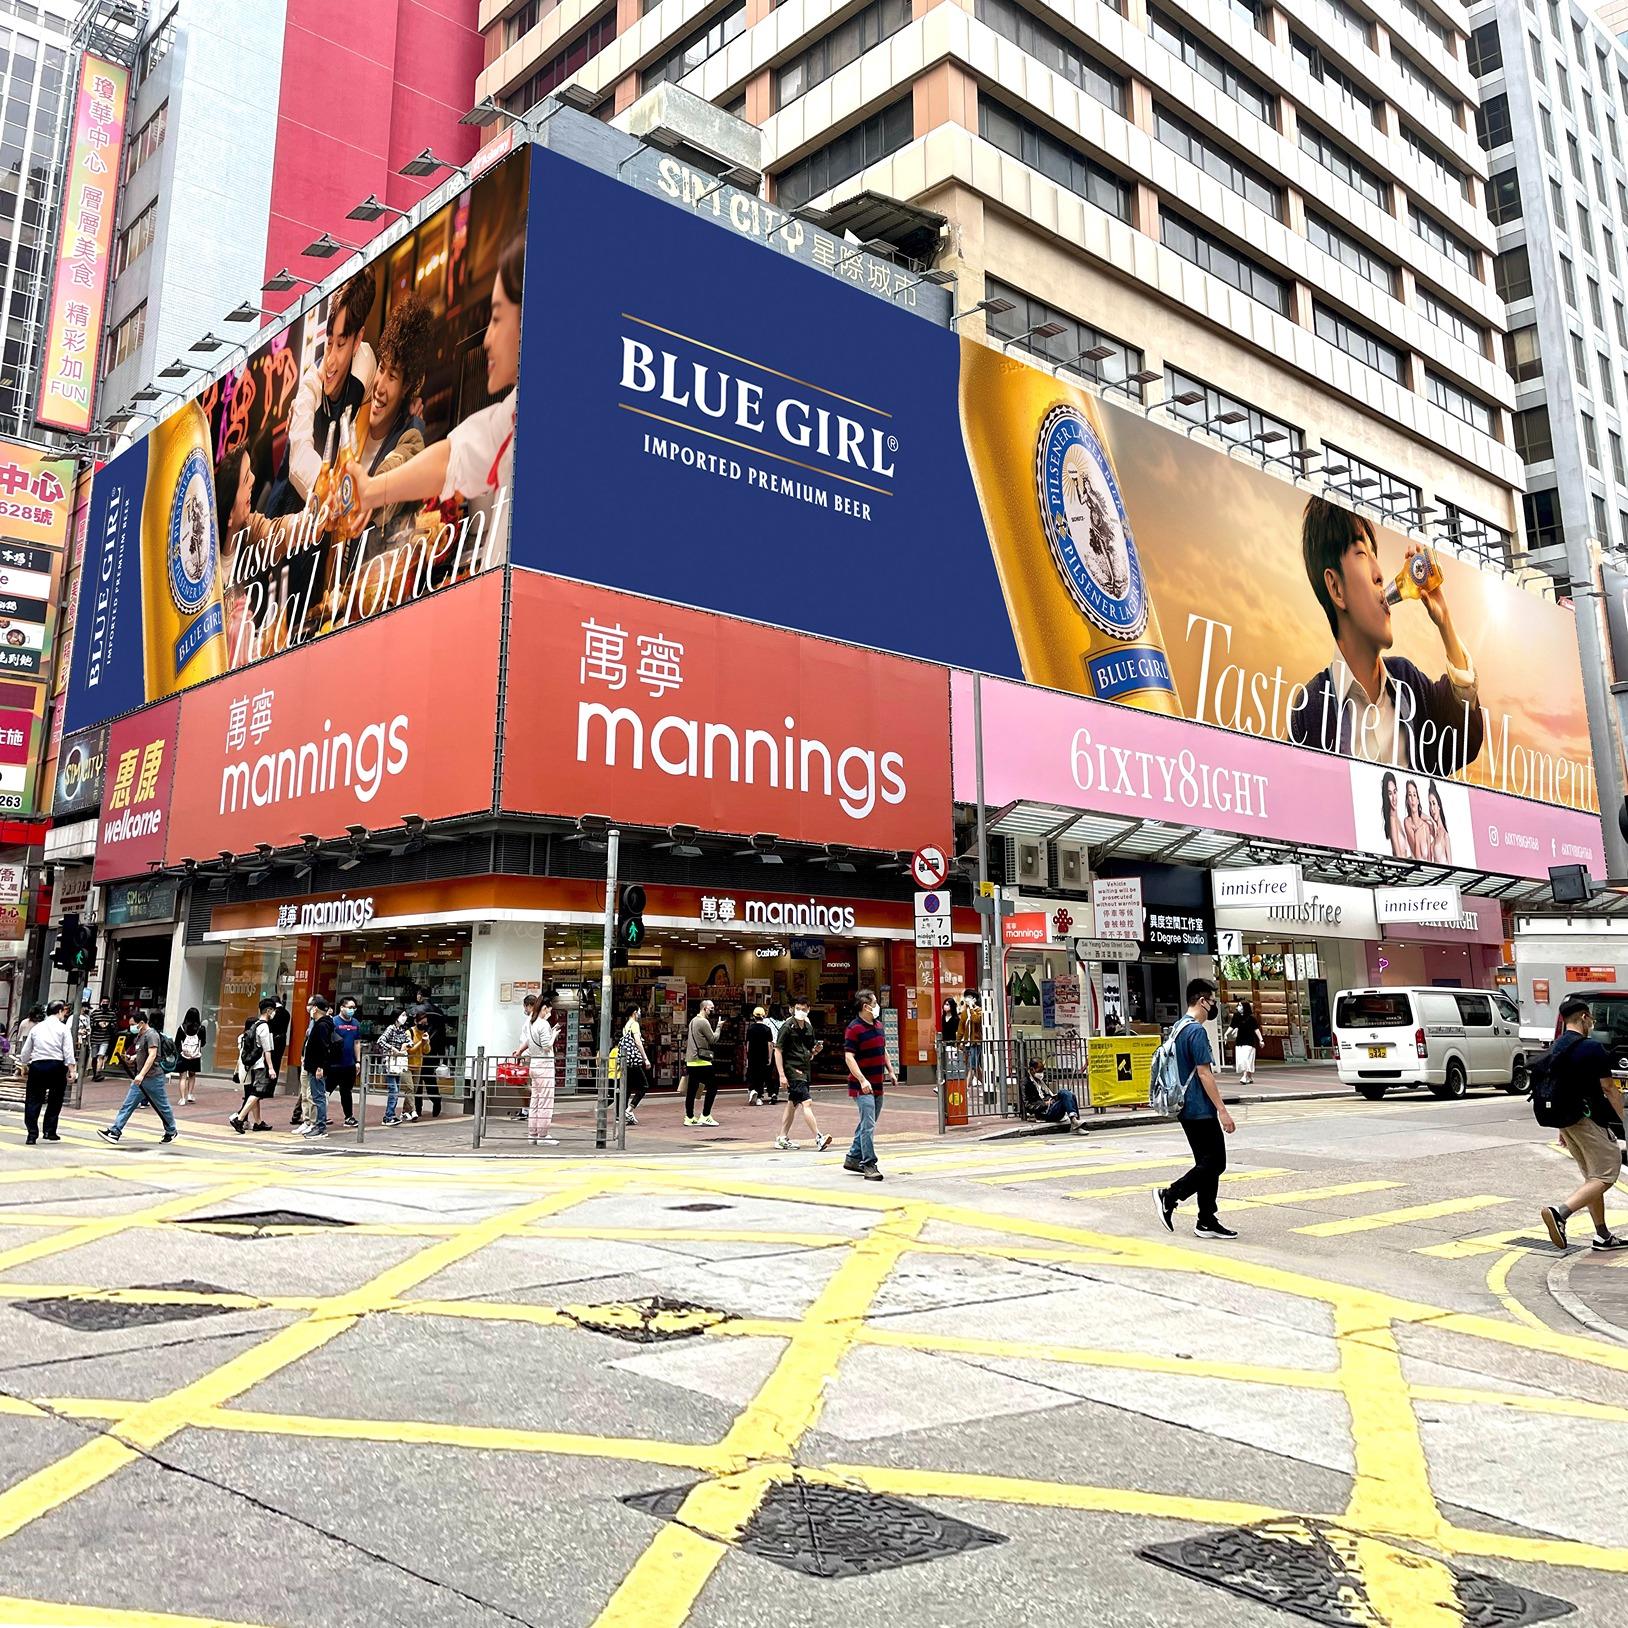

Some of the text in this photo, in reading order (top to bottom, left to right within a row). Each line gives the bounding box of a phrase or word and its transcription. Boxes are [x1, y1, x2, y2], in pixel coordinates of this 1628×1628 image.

[84, 75, 116, 175] 瓊華中心
[70, 185, 106, 289] 層層美食
[657, 157, 917, 307] SIM CITY 星際城市
[59, 300, 91, 380] 精彩加
[50, 379, 88, 403] FUN
[619, 335, 765, 434] BLUE
[643, 434, 872, 522] IMPORTED PREMIUM BEER
[1051, 425, 1073, 506] PILSENER
[1071, 424, 1104, 470] LAGER
[173, 469, 192, 538] PILSENER
[225, 486, 331, 590] Taste the
[106, 598, 120, 665] IMPORTED
[114, 532, 127, 595] PREMIUM
[175, 562, 198, 600] PILSENER
[232, 486, 511, 671] Real Moment
[1064, 545, 1118, 620] PILSENER
[1118, 588, 1141, 622] LAGER
[87, 587, 111, 690] BLUE
[178, 610, 223, 663] BLUE GIRL
[579, 616, 686, 699] 萬寧
[1096, 656, 1170, 691] BLUE GIRL
[225, 686, 275, 756] 萬寧
[1186, 613, 1598, 815] Taste the Real Moment
[109, 738, 167, 812] 惠康
[219, 713, 410, 816] mannings
[575, 700, 908, 821] mannings
[1070, 726, 1271, 819] 6IXTY8IGHT
[0, 795, 21, 808] 263
[103, 808, 163, 846] wellcome
[277, 904, 299, 929] 萬寧
[301, 894, 375, 929] mannings
[700, 895, 737, 924] 萬寧
[745, 898, 856, 934] mannings
[1221, 879, 1288, 897] innisfree
[1385, 898, 1449, 913] innisfree
[755, 948, 780, 958] Cashier
[937, 918, 943, 928] 7
[938, 935, 950, 946] 12
[1005, 928, 1044, 940] mannings
[1150, 931, 1205, 945] 2 Degree Studio
[224, 982, 257, 997] mannings
[826, 961, 851, 969] mannings
